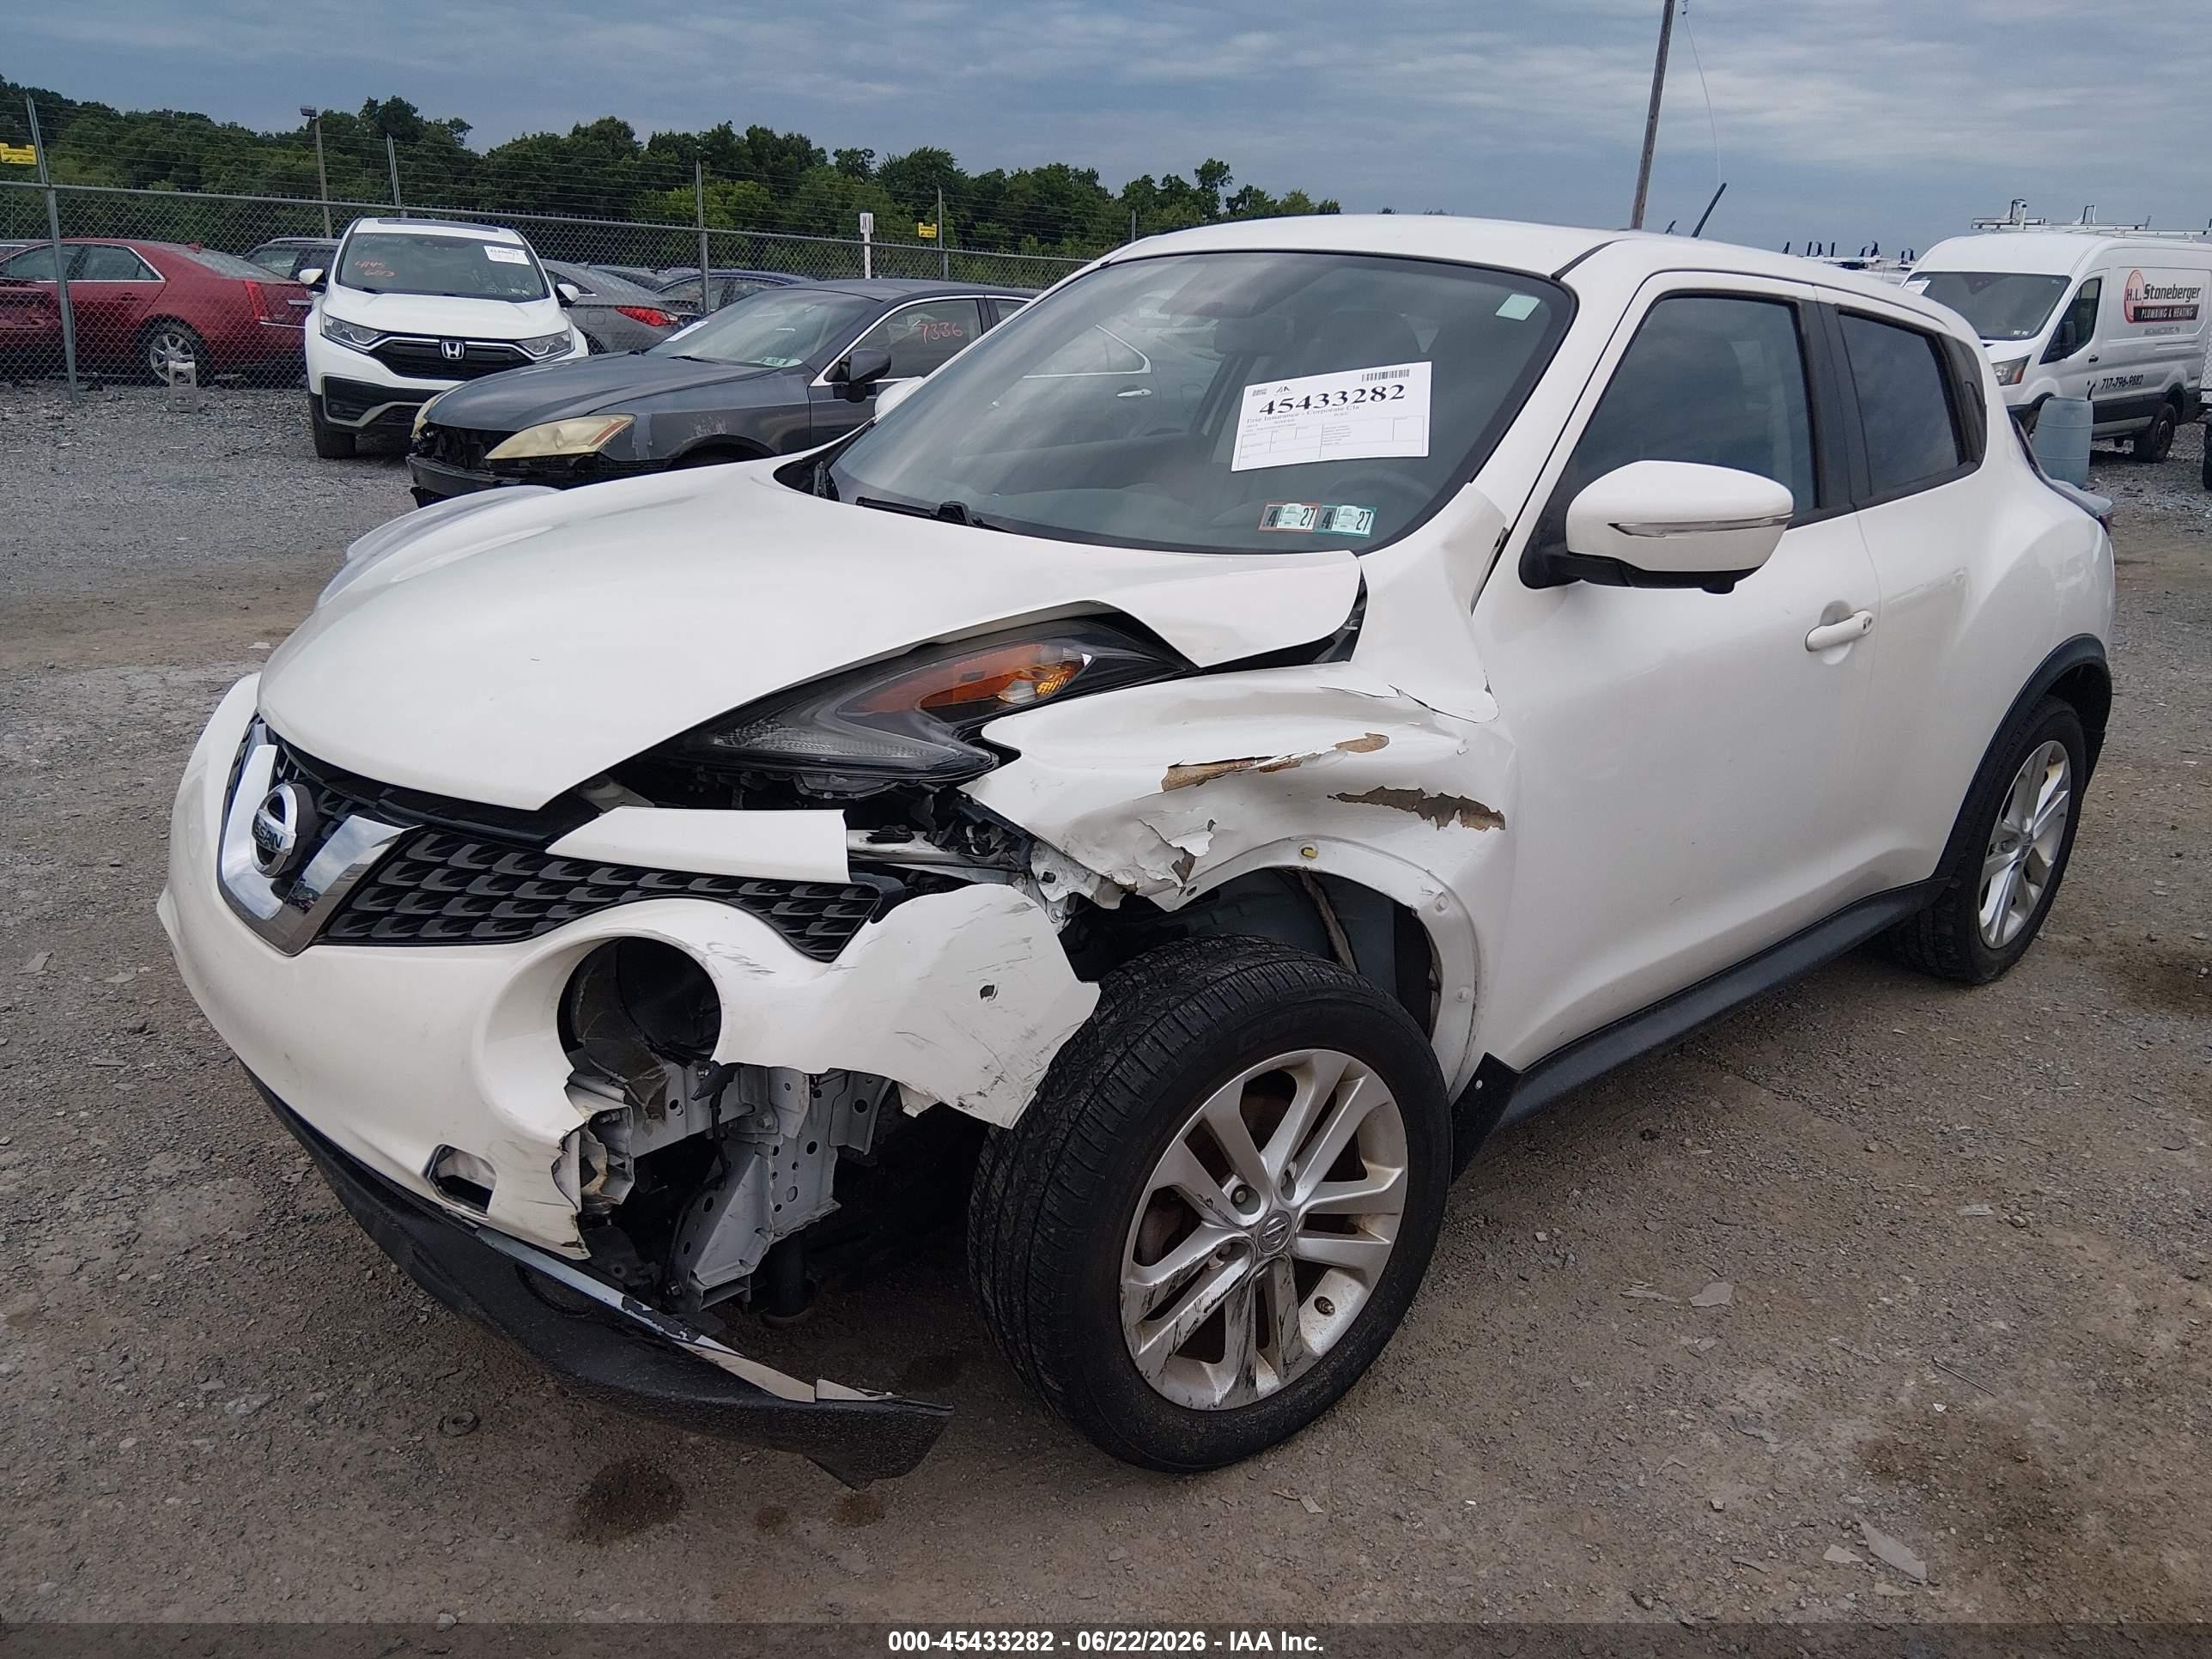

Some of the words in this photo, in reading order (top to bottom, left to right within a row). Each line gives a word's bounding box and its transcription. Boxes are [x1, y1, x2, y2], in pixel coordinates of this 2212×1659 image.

[2126, 288, 2142, 301] H.L.
[2143, 283, 2202, 303] Stoneberger
[2141, 308, 2168, 319] PLUMBING
[2173, 307, 2193, 318] HEATING
[1259, 384, 1406, 416] 45433282
[1300, 507, 1316, 528] 27
[1356, 511, 1371, 532] 27
